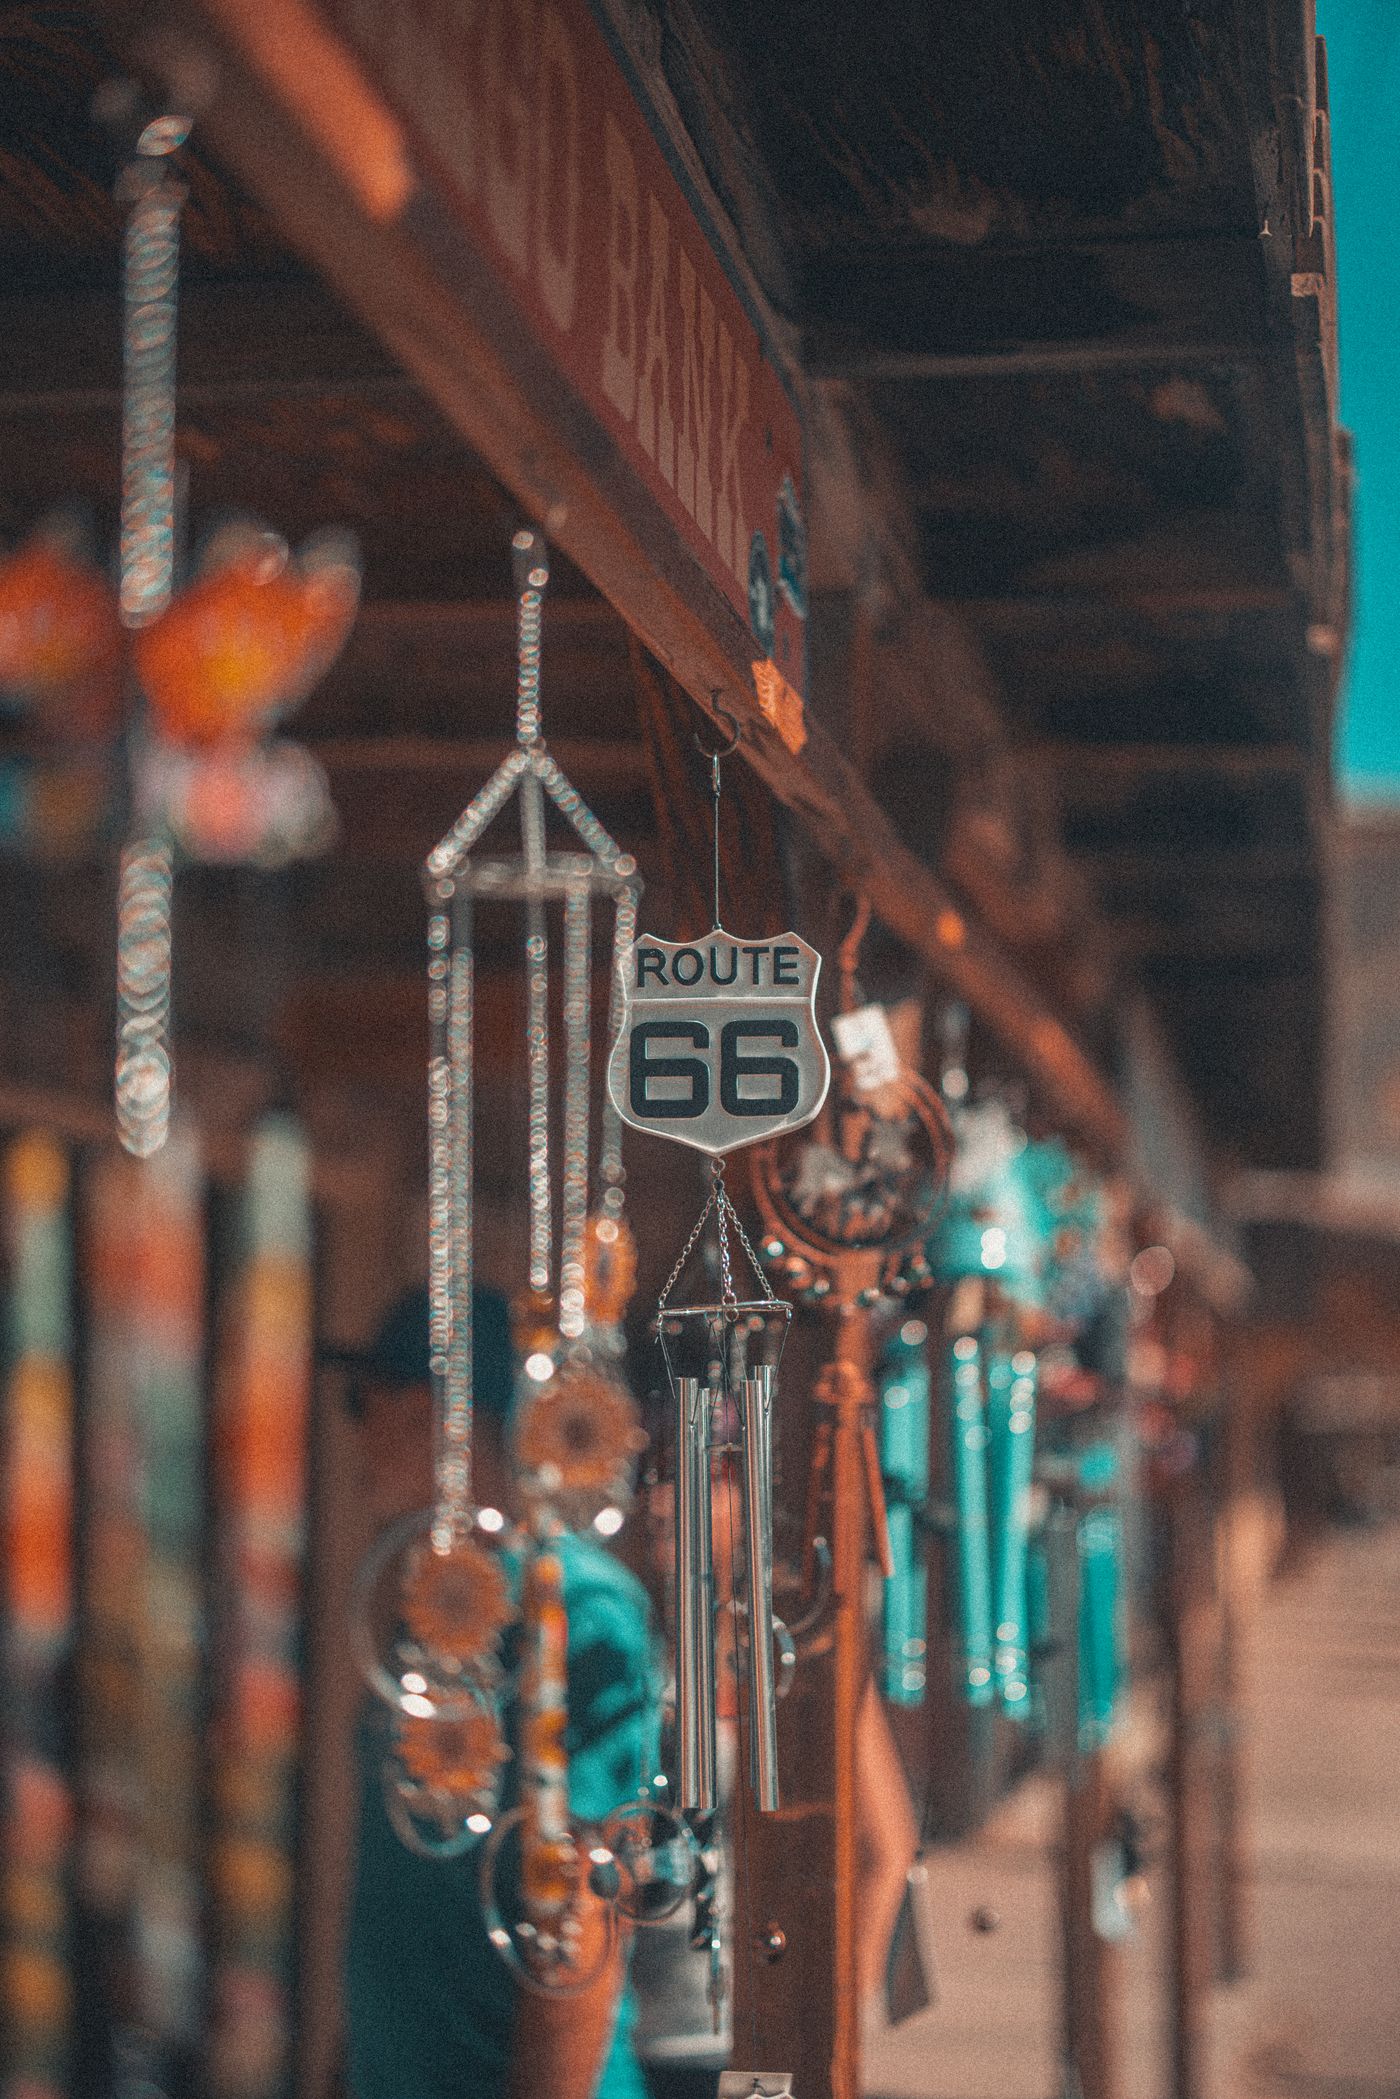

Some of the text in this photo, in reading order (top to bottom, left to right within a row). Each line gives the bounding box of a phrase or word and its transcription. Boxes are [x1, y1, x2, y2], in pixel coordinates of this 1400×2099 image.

[602, 109, 751, 591] BANK
[636, 946, 801, 988] ROUTE
[629, 1019, 800, 1119] 66
